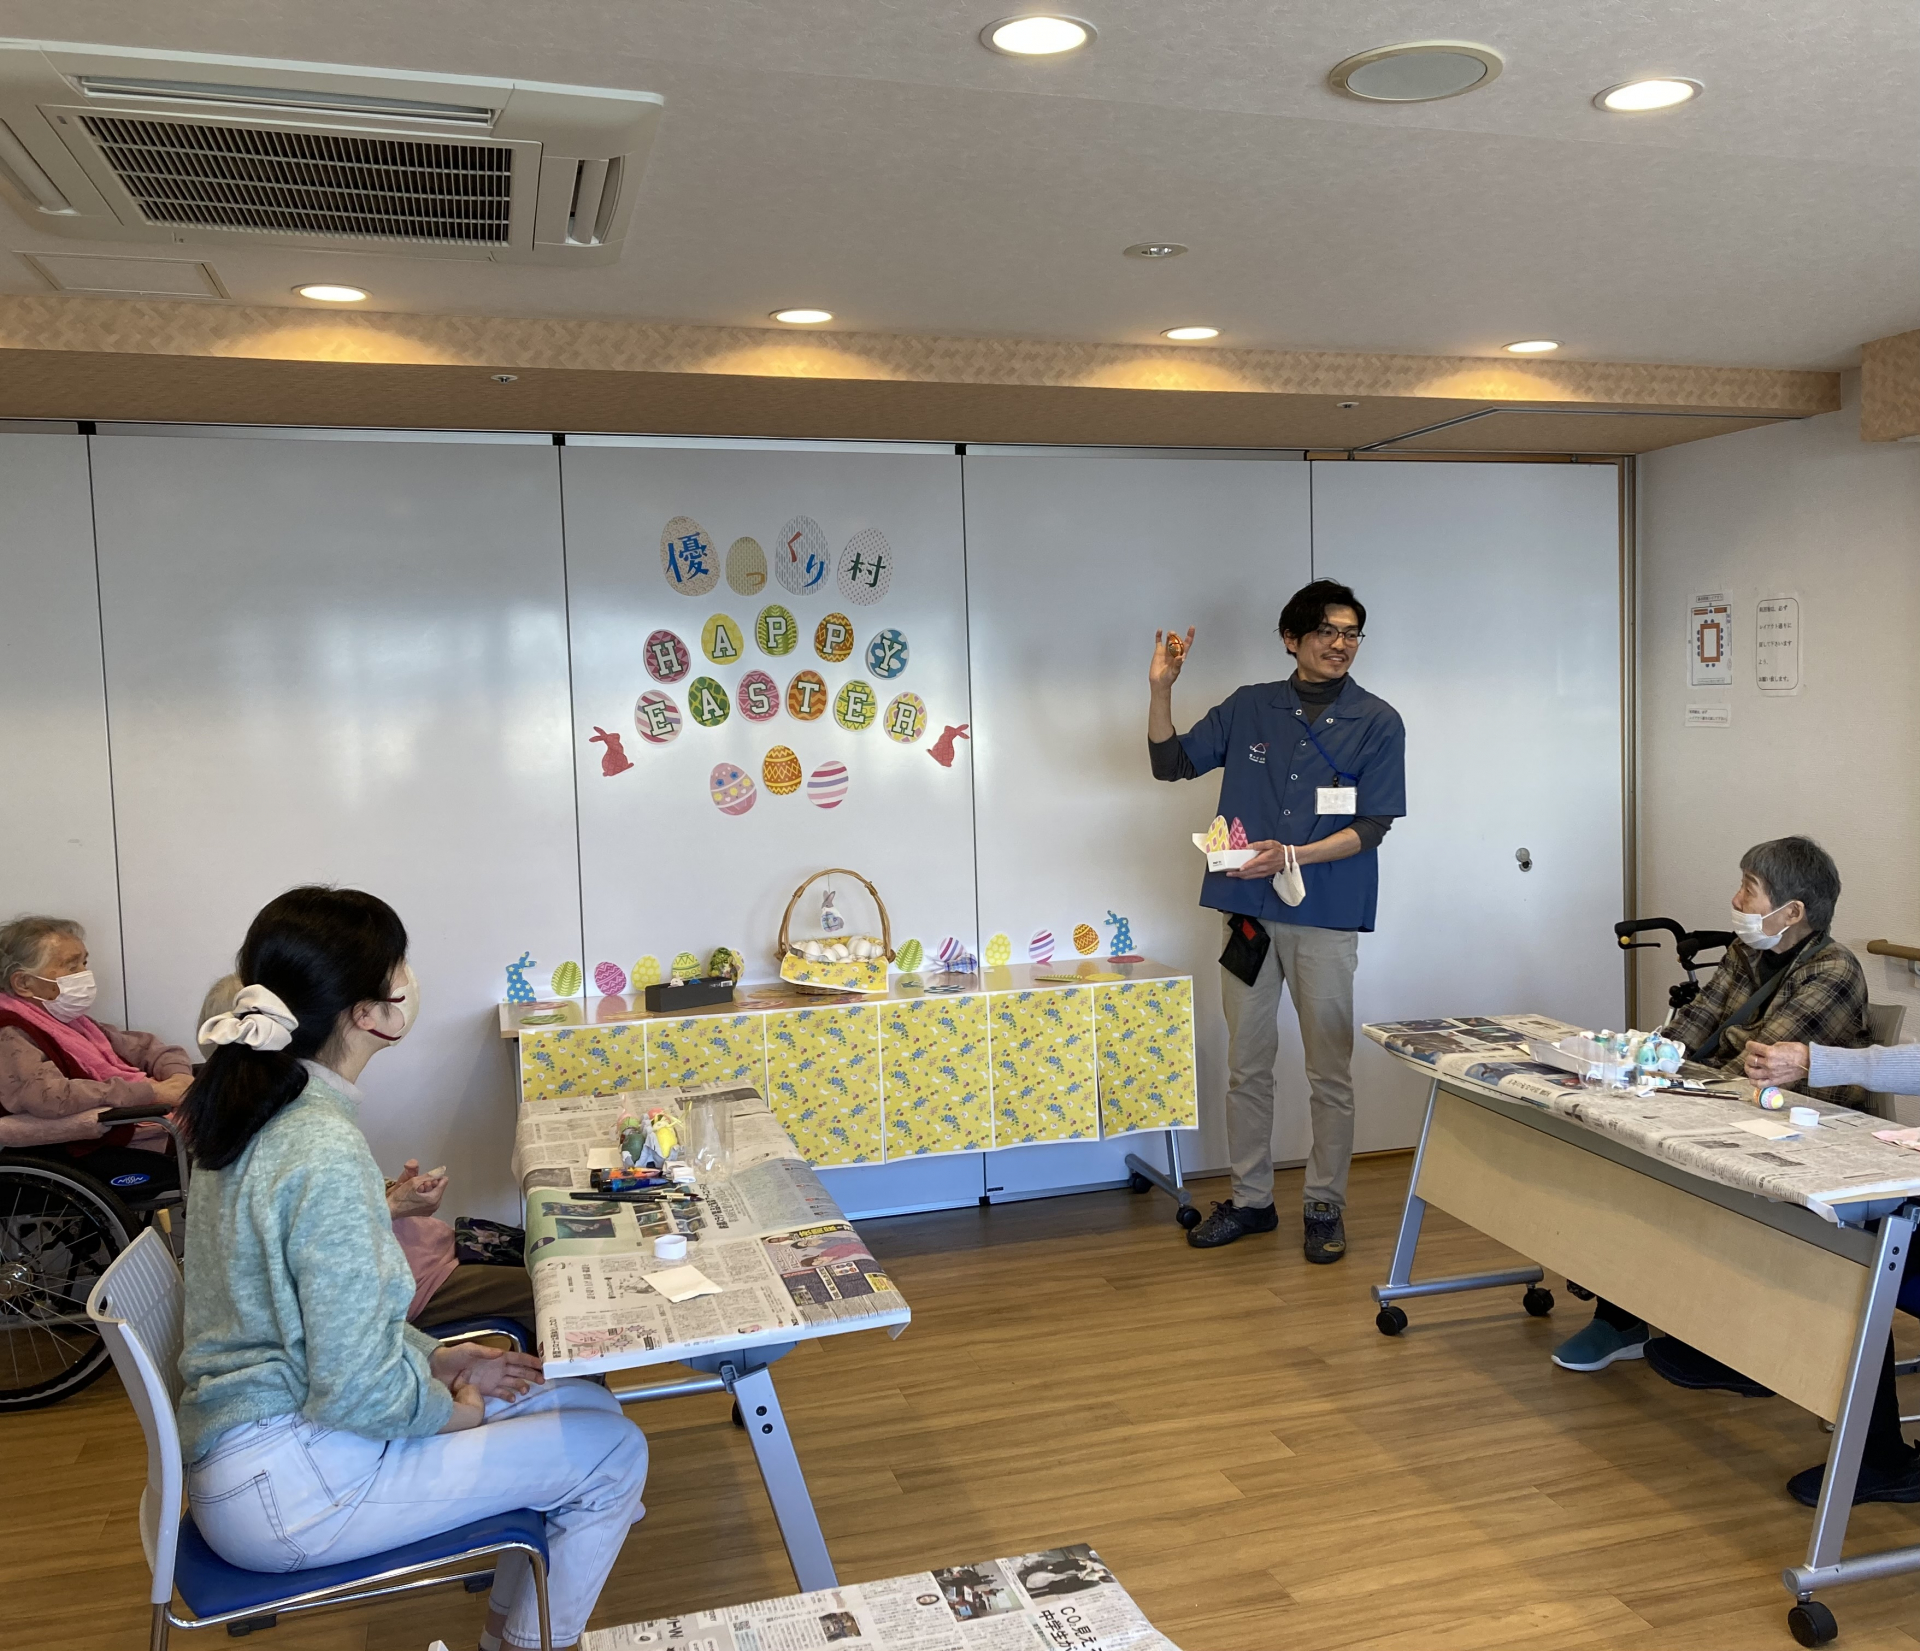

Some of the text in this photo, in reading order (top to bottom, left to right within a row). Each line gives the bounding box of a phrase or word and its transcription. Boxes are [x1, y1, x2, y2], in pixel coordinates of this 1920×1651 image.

[666, 530, 886, 588] 優っくり村
[652, 615, 902, 678] HAPPY
[642, 681, 917, 738] EASTER
